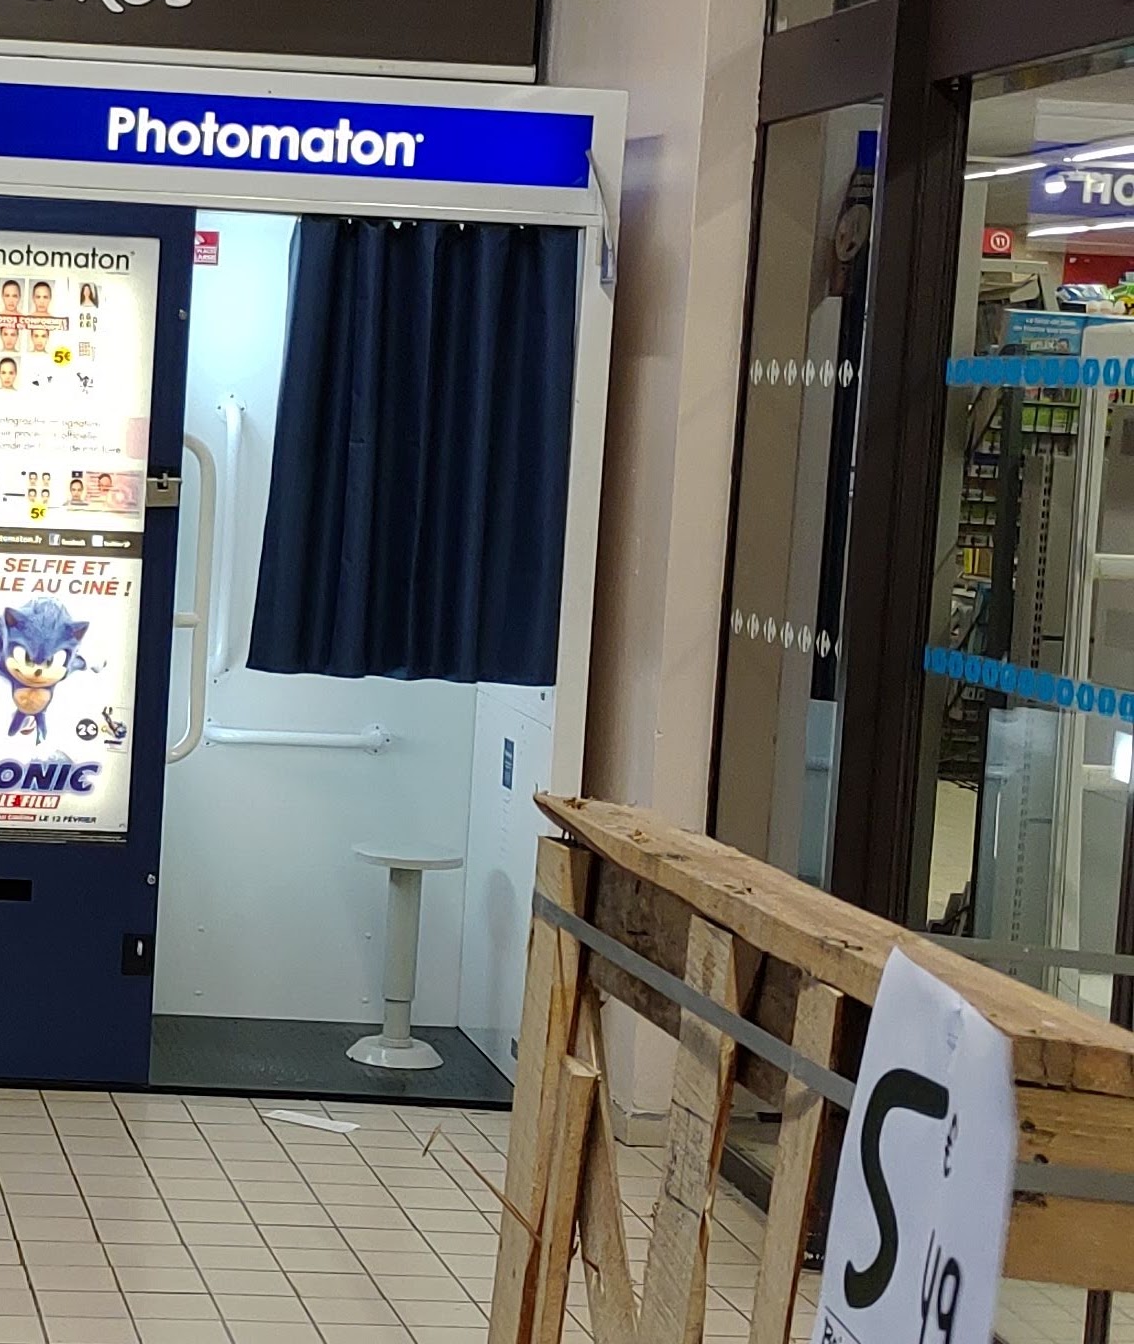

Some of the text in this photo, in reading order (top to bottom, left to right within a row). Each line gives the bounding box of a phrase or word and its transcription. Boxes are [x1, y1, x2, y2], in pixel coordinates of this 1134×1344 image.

[106, 107, 420, 168] Photomaton
[54, 350, 72, 364] 5€
[30, 507, 48, 519] 5€
[3, 558, 76, 575] SELFIE
[83, 561, 110, 576] ET
[31, 578, 61, 594] AU
[68, 577, 119, 596] CINÉ
[19, 795, 59, 809] FILM
